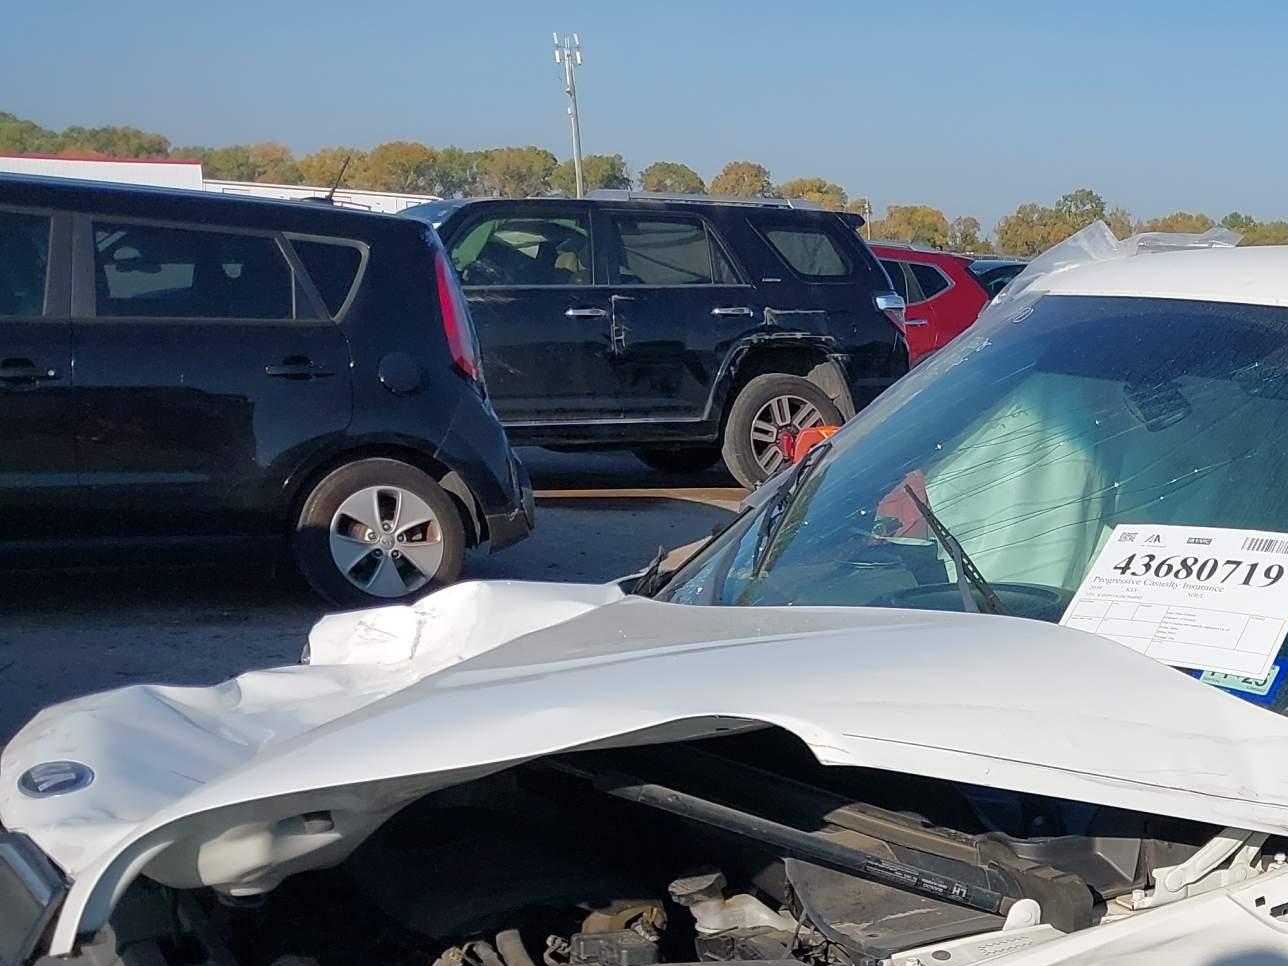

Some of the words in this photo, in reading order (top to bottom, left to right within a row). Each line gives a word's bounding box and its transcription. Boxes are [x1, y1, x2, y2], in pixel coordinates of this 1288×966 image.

[1112, 552, 1286, 588] 43680719
[1092, 575, 1142, 588] Progressive
[1143, 578, 1180, 591] Casualty
[1182, 581, 1225, 593] Insurance
